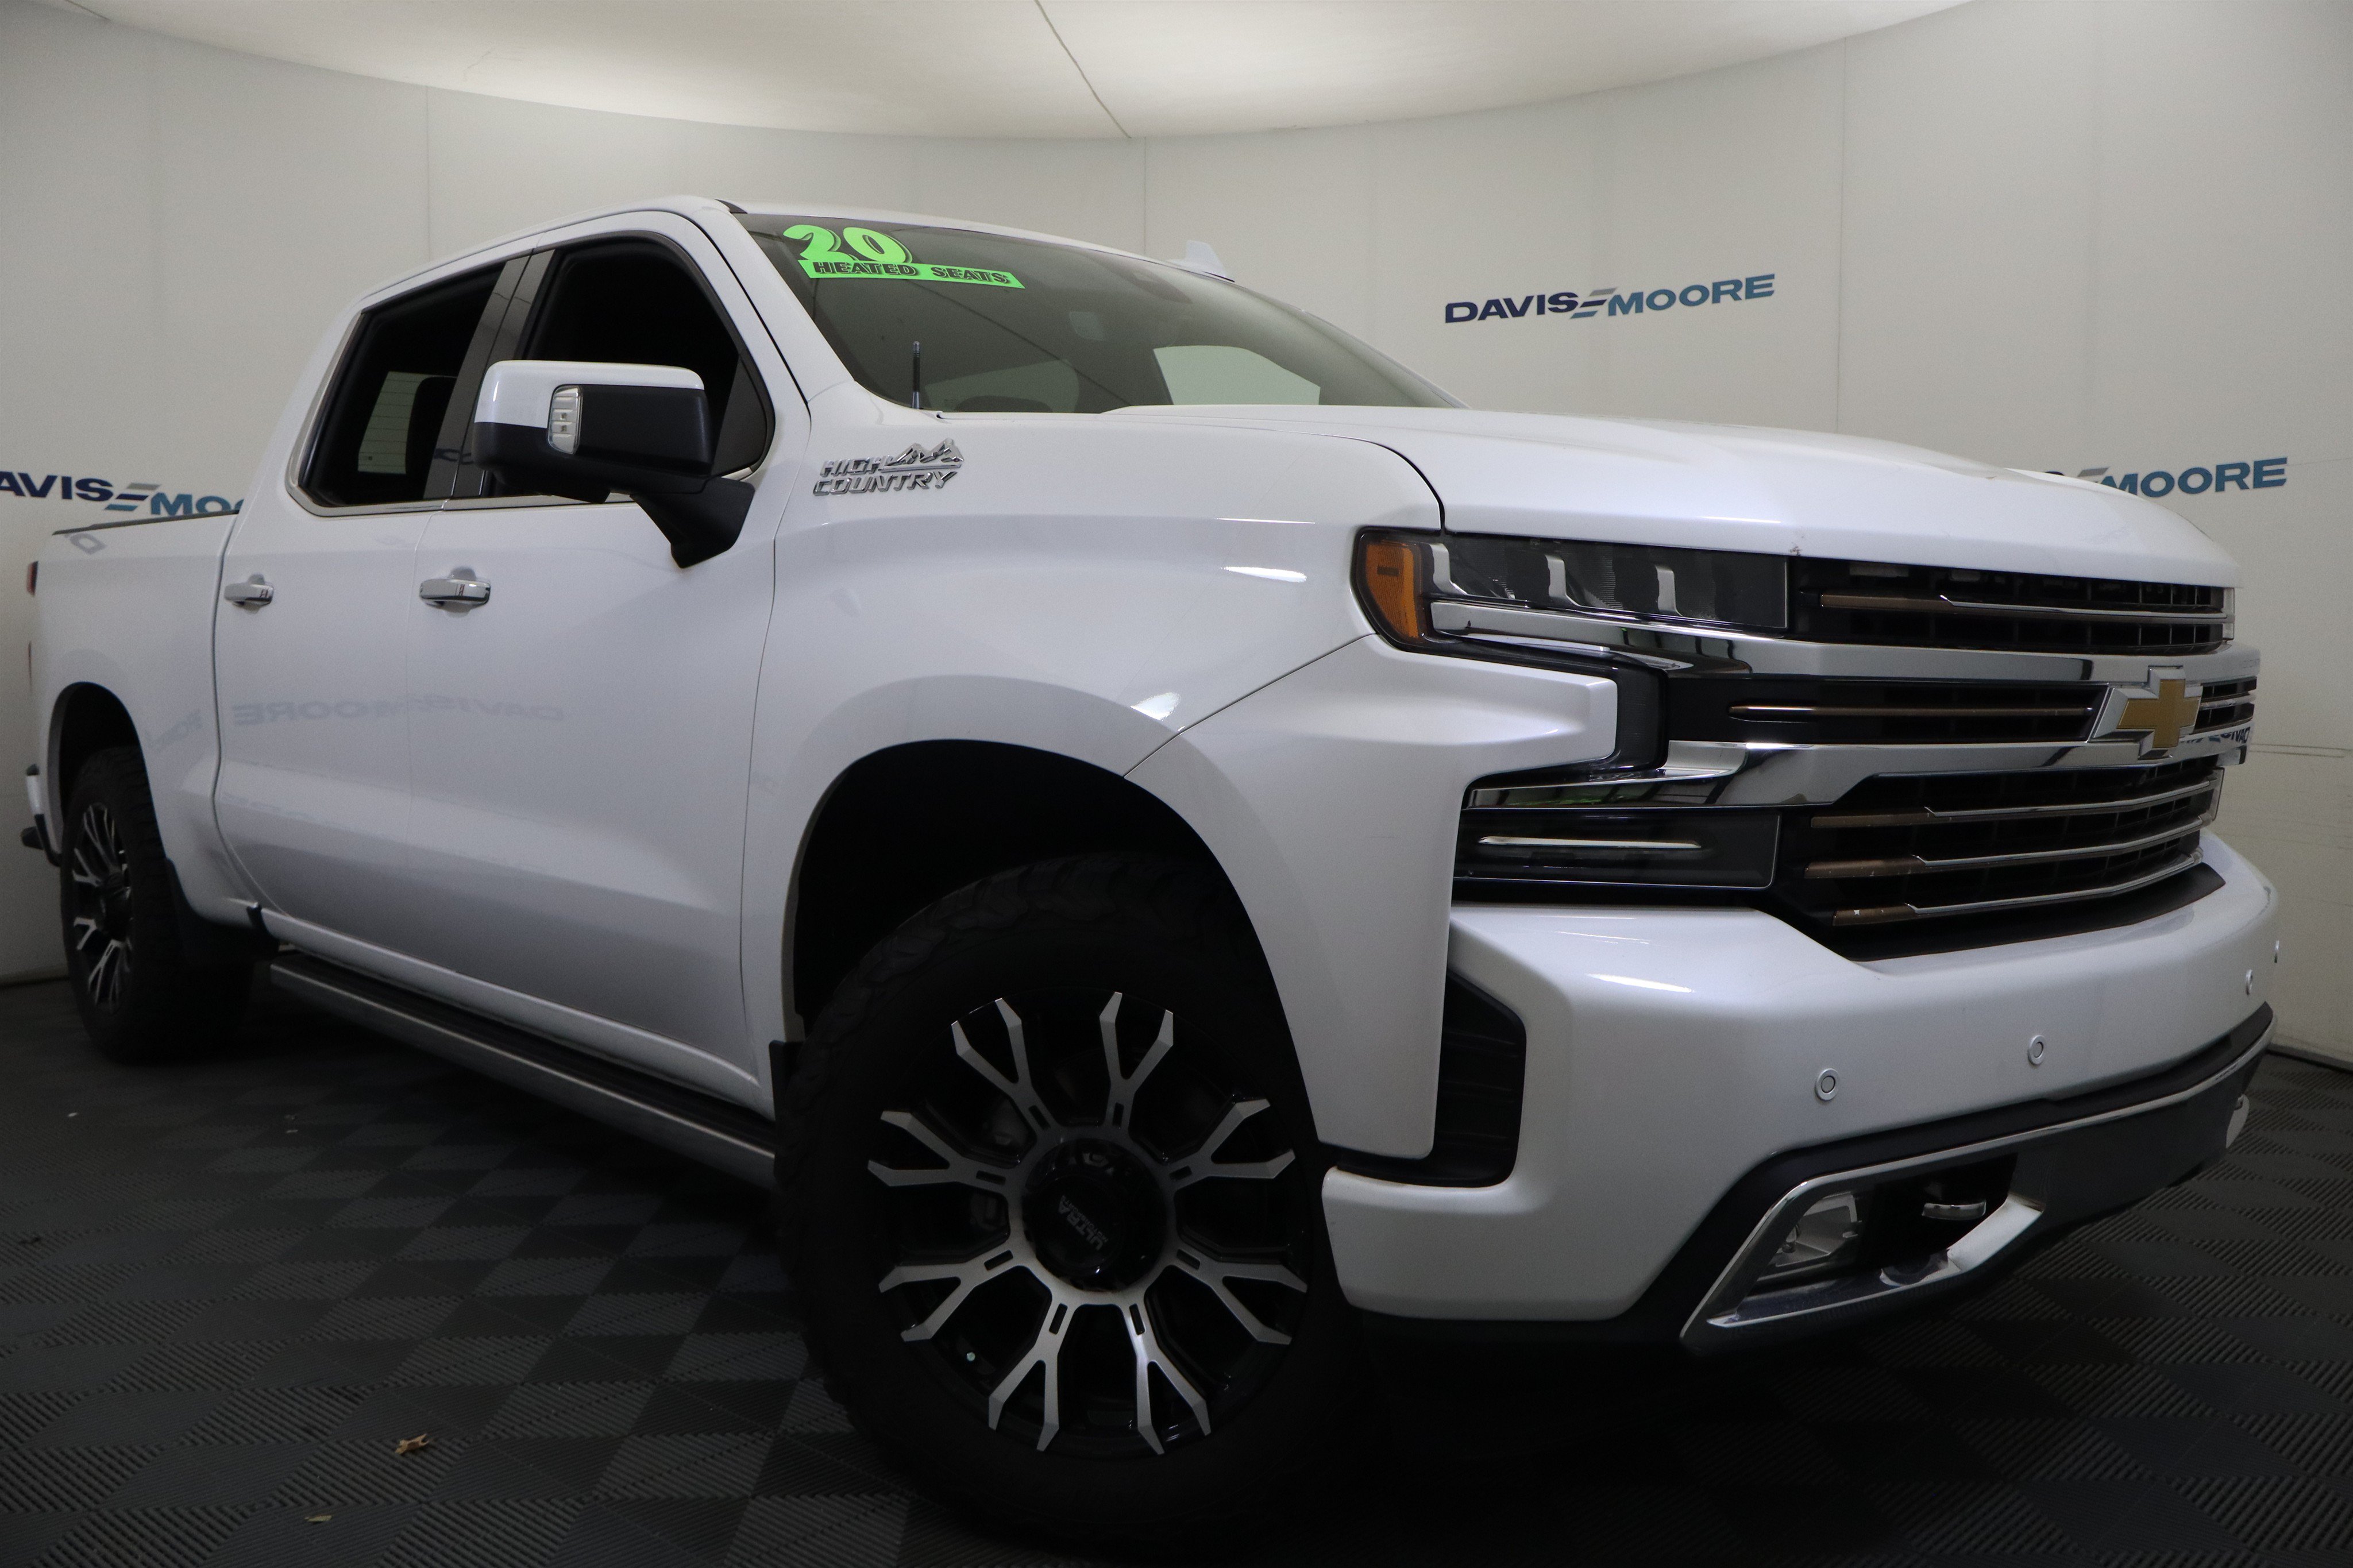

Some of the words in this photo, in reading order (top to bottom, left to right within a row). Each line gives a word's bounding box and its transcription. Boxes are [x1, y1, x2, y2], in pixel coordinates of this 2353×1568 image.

[783, 225, 912, 263] 20
[812, 261, 919, 276] HEATED
[932, 267, 1010, 284] SEATS
[1445, 292, 1579, 323] DAVIS
[1607, 273, 1776, 316] MOORE
[820, 455, 893, 477] HIGH
[813, 471, 958, 496] COUNTRY
[1058, 1195, 1104, 1251] ULTRA
